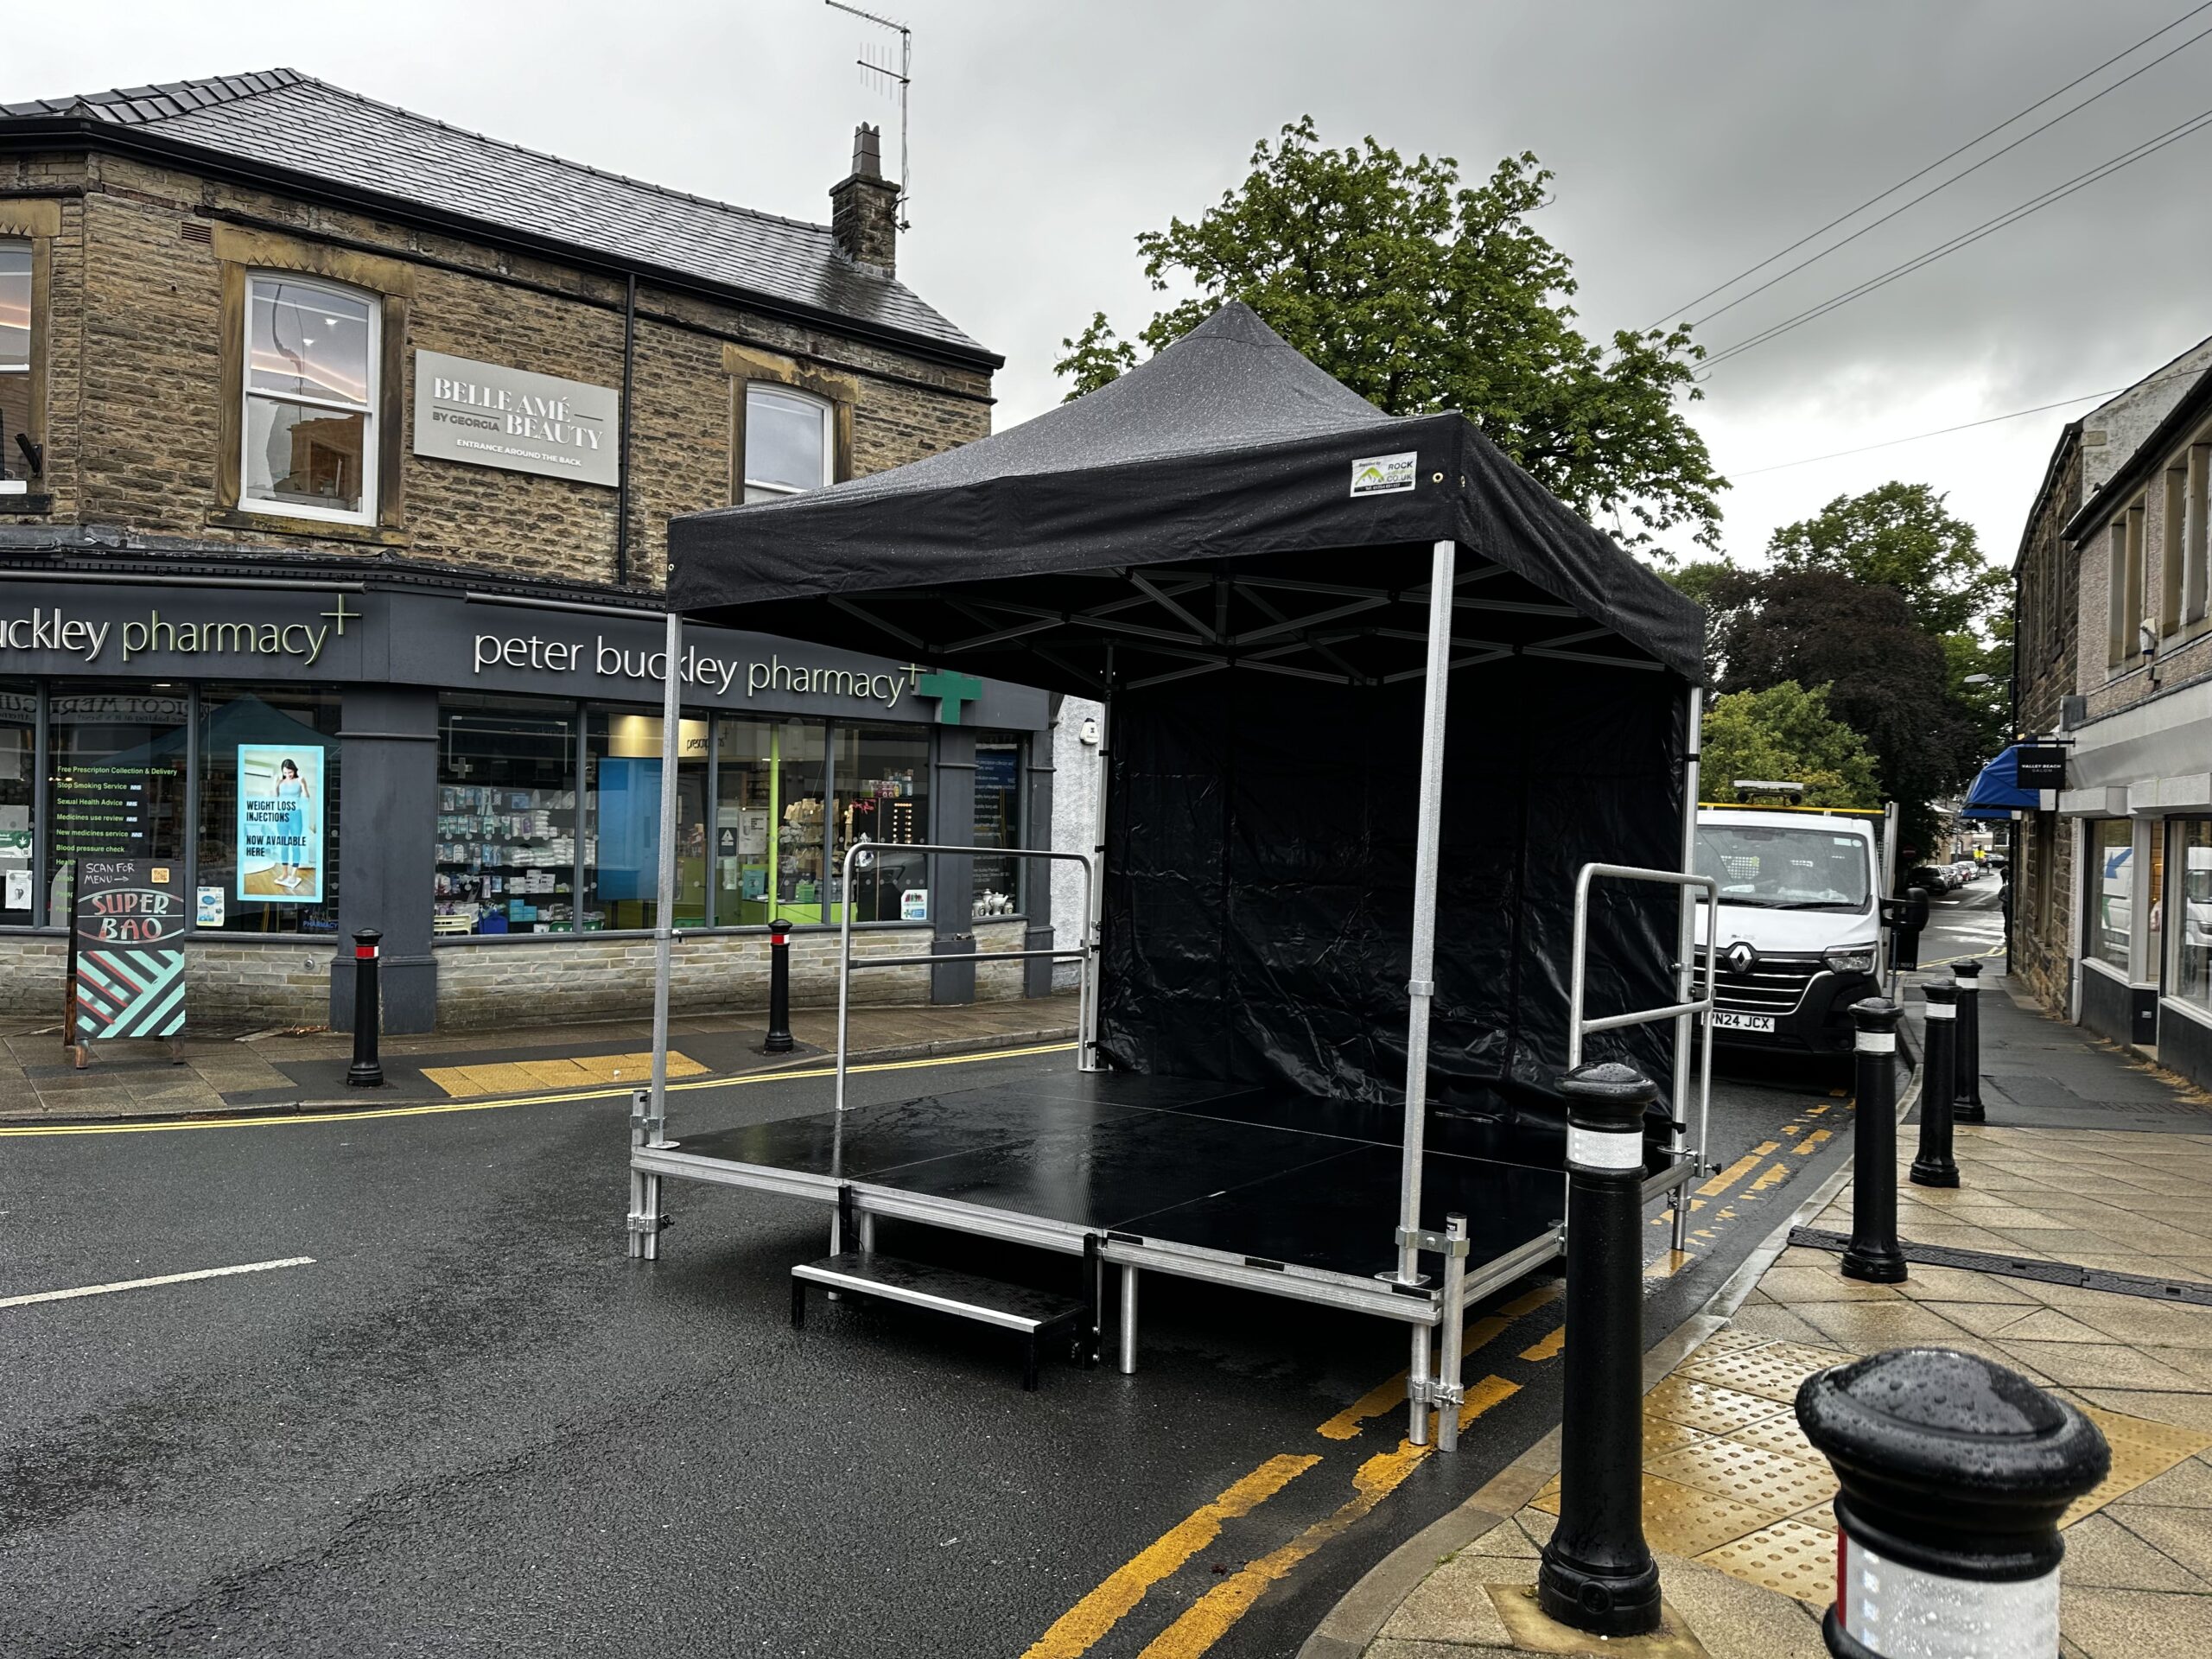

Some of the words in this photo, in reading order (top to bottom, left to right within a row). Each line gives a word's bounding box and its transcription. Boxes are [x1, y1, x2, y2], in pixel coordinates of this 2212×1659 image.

[433, 377, 512, 411] BELLE
[517, 394, 571, 423] AMÉ
[432, 411, 448, 422] BY
[449, 414, 500, 431] GEORGIA
[505, 413, 603, 450] BEAUTY
[456, 439, 503, 454] ENTRANCE
[504, 446, 541, 460] AROUND
[542, 453, 557, 463] THE
[559, 456, 582, 467] BACK
[1388, 461, 1414, 470] ROCK
[0, 607, 111, 661] ckley
[123, 610, 332, 665] pharmacy
[474, 634, 584, 673] peter
[747, 654, 906, 709] pharmacy
[73, 782, 102, 791] Smoking
[246, 800, 275, 810] WEIGHT
[276, 801, 296, 811] LOSS
[246, 812, 289, 823] INJECTIONS
[246, 835, 264, 845] NOW
[266, 836, 306, 846] AVAILABLE
[246, 847, 265, 856] HERE
[86, 862, 114, 874] SCAN
[84, 874, 113, 885] MENU
[92, 893, 169, 916] SUPER
[99, 917, 162, 940] BAO
[1744, 1016, 1770, 1030] JCX
